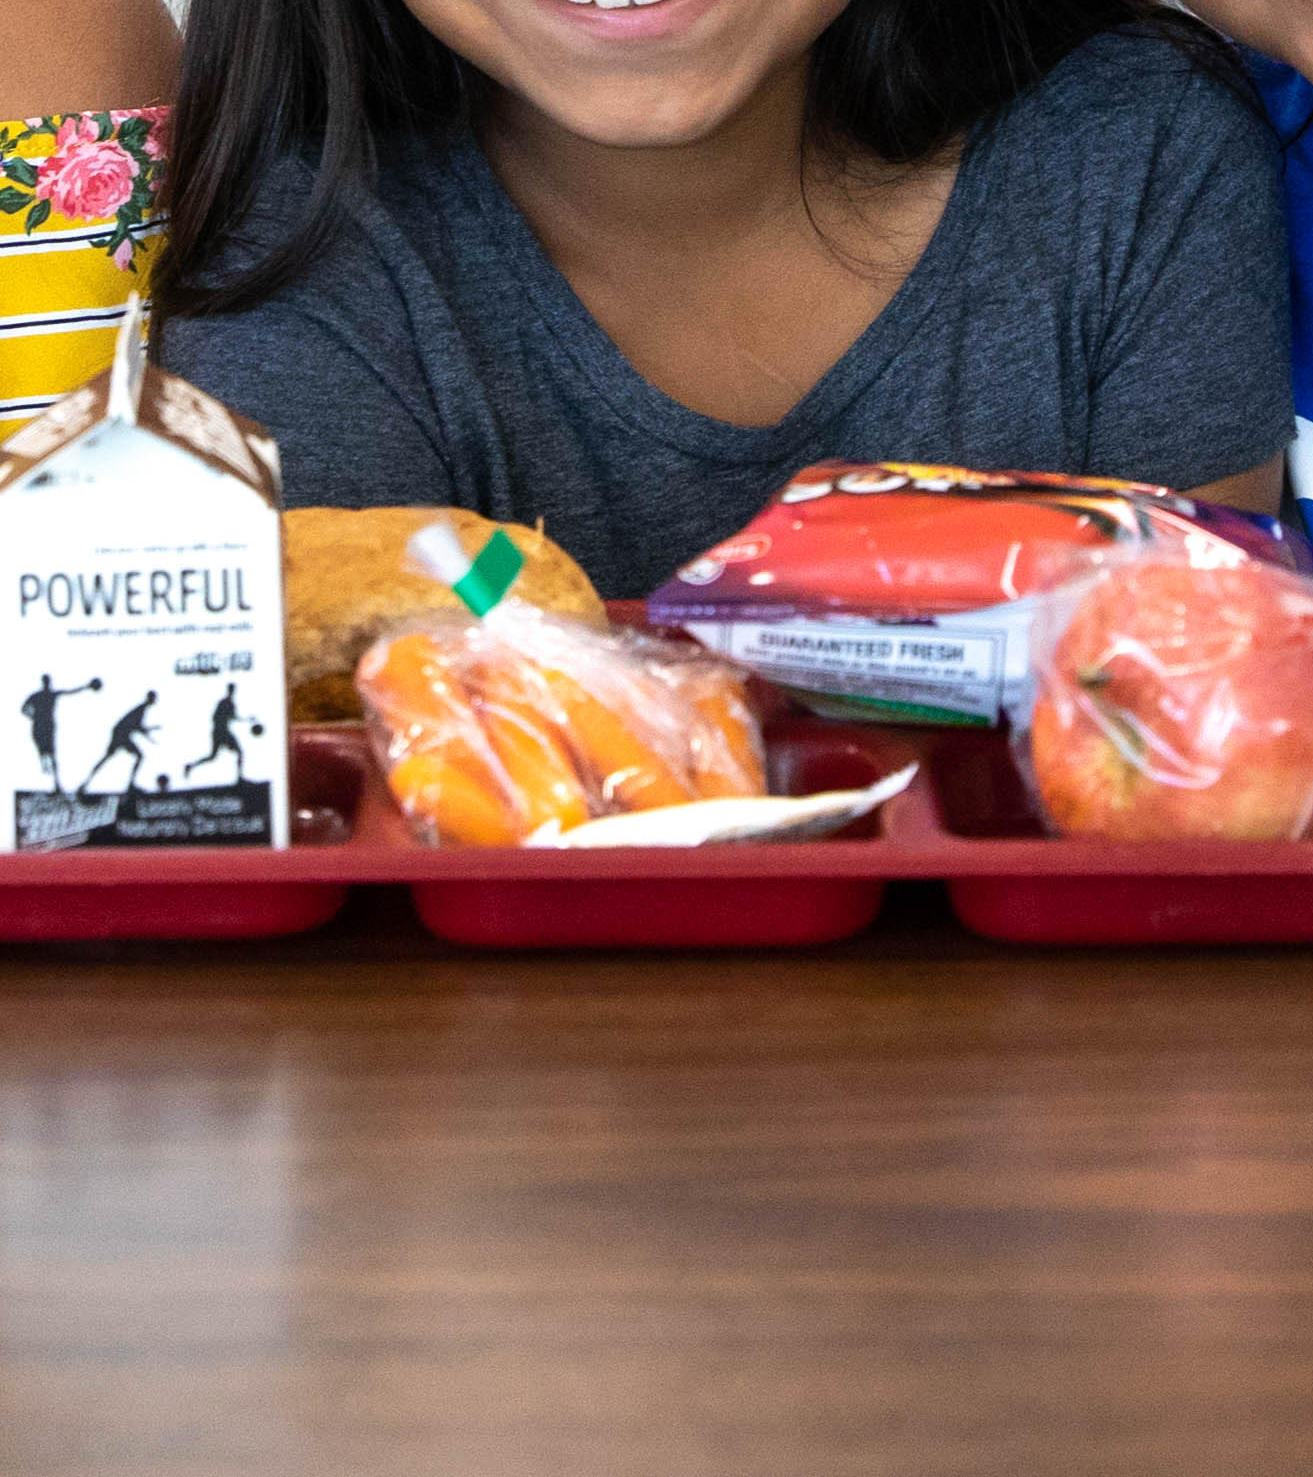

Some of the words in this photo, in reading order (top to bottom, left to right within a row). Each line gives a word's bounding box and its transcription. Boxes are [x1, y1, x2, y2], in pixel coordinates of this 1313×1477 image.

[18, 568, 253, 618] POWERFUL
[759, 632, 894, 659] GUARANTEED
[899, 639, 966, 662] FRESH
